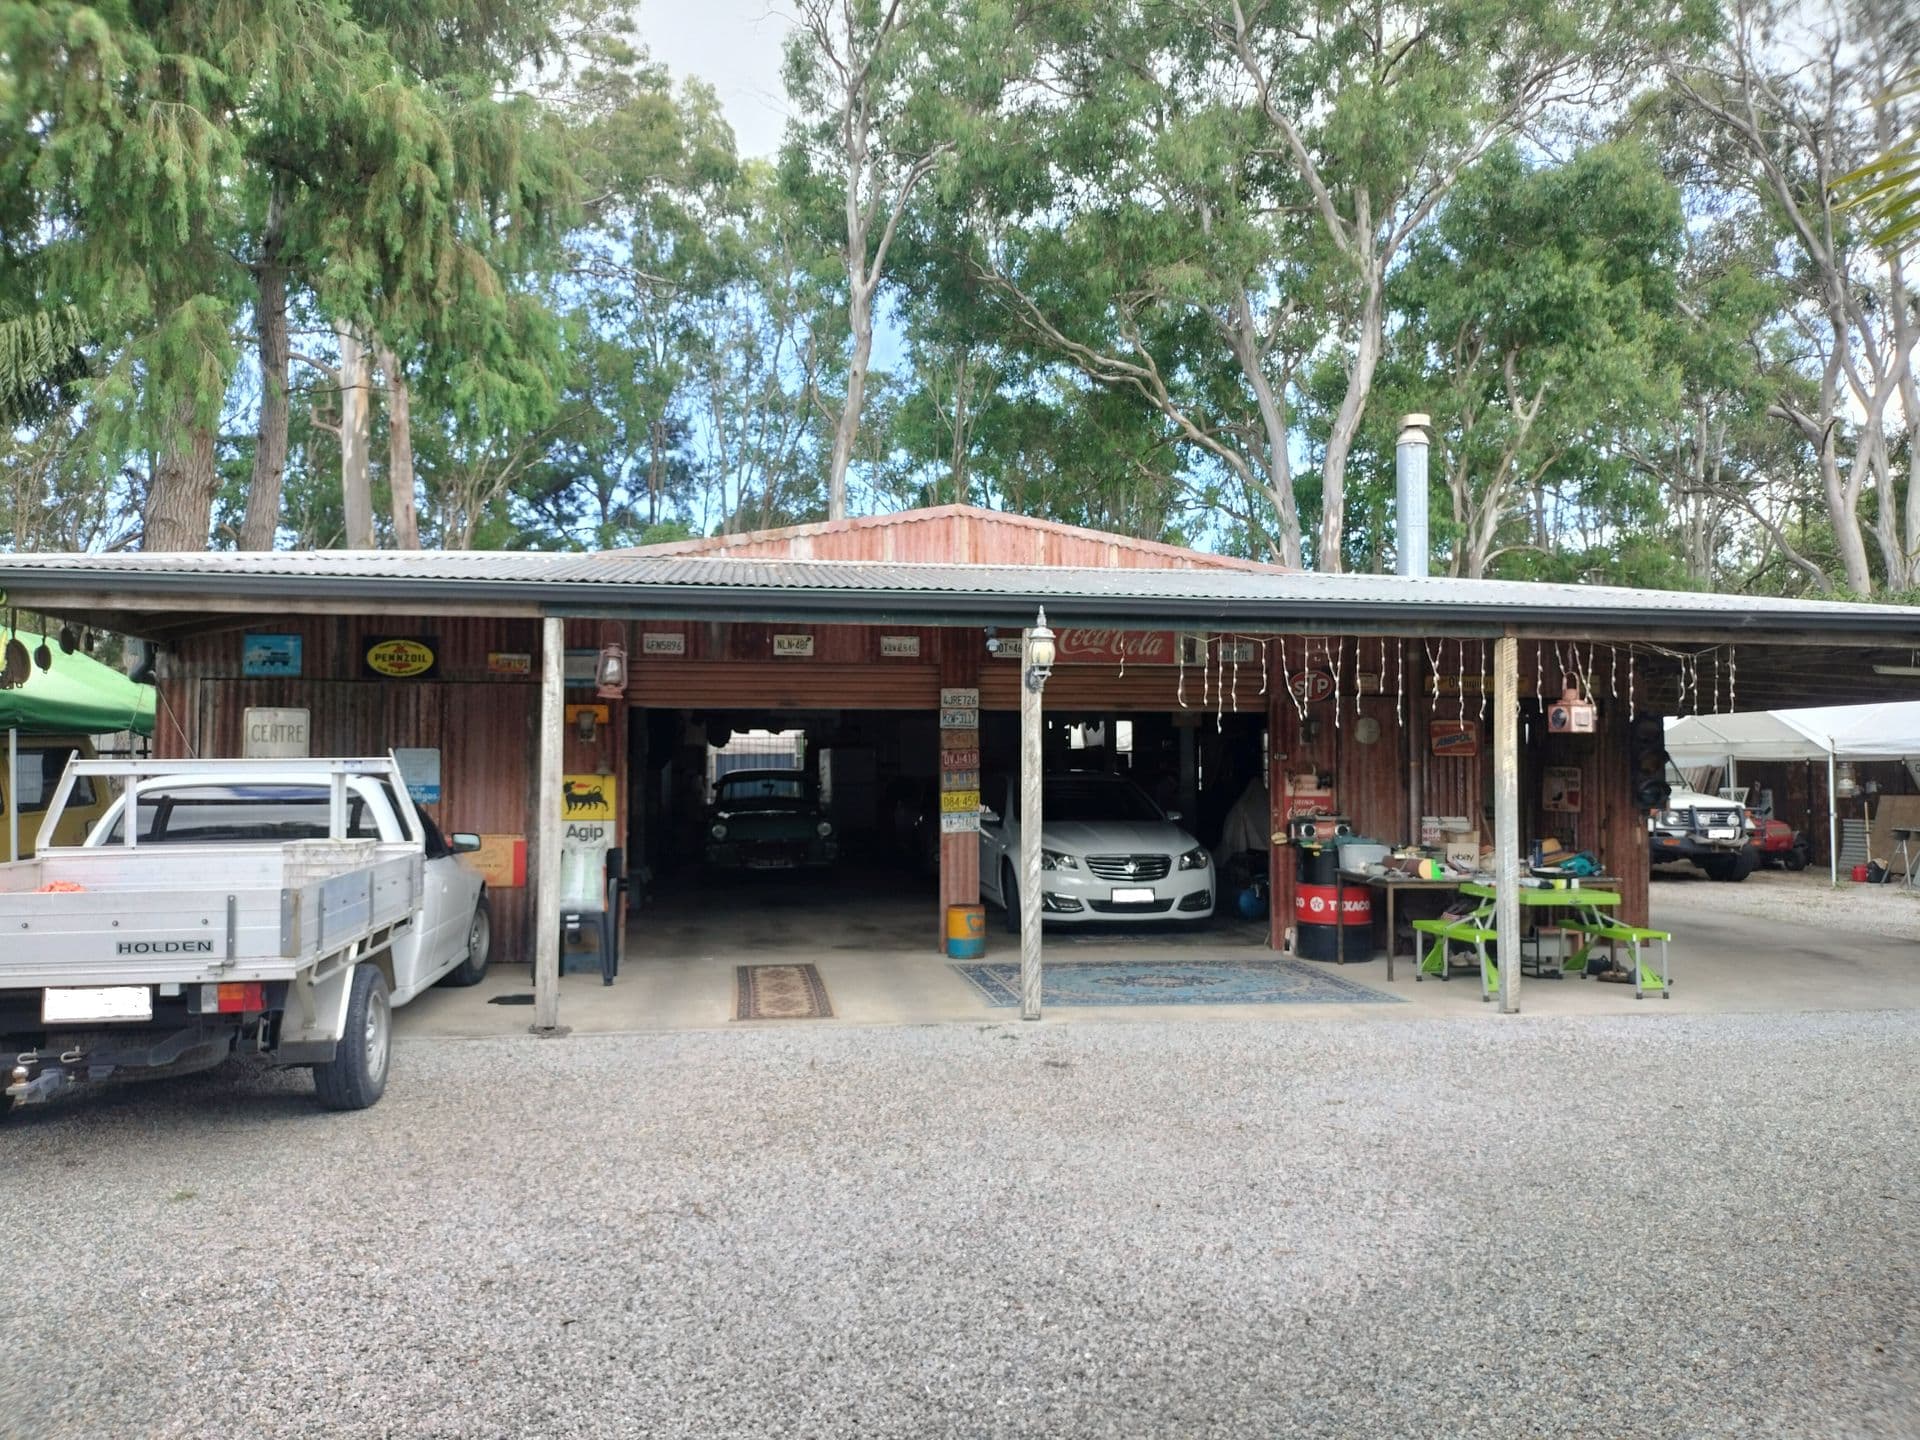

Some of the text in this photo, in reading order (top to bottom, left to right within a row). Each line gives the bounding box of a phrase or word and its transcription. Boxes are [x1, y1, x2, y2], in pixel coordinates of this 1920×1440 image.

[374, 653, 426, 663] PENNZOIL
[1294, 673, 1328, 698] STP
[251, 723, 305, 743] CENTRE
[1436, 733, 1473, 747] AMPOL
[566, 823, 605, 842] Agip
[1452, 851, 1475, 862] ebay
[1328, 899, 1371, 912] TXACO
[118, 940, 213, 955] HOLDEN
